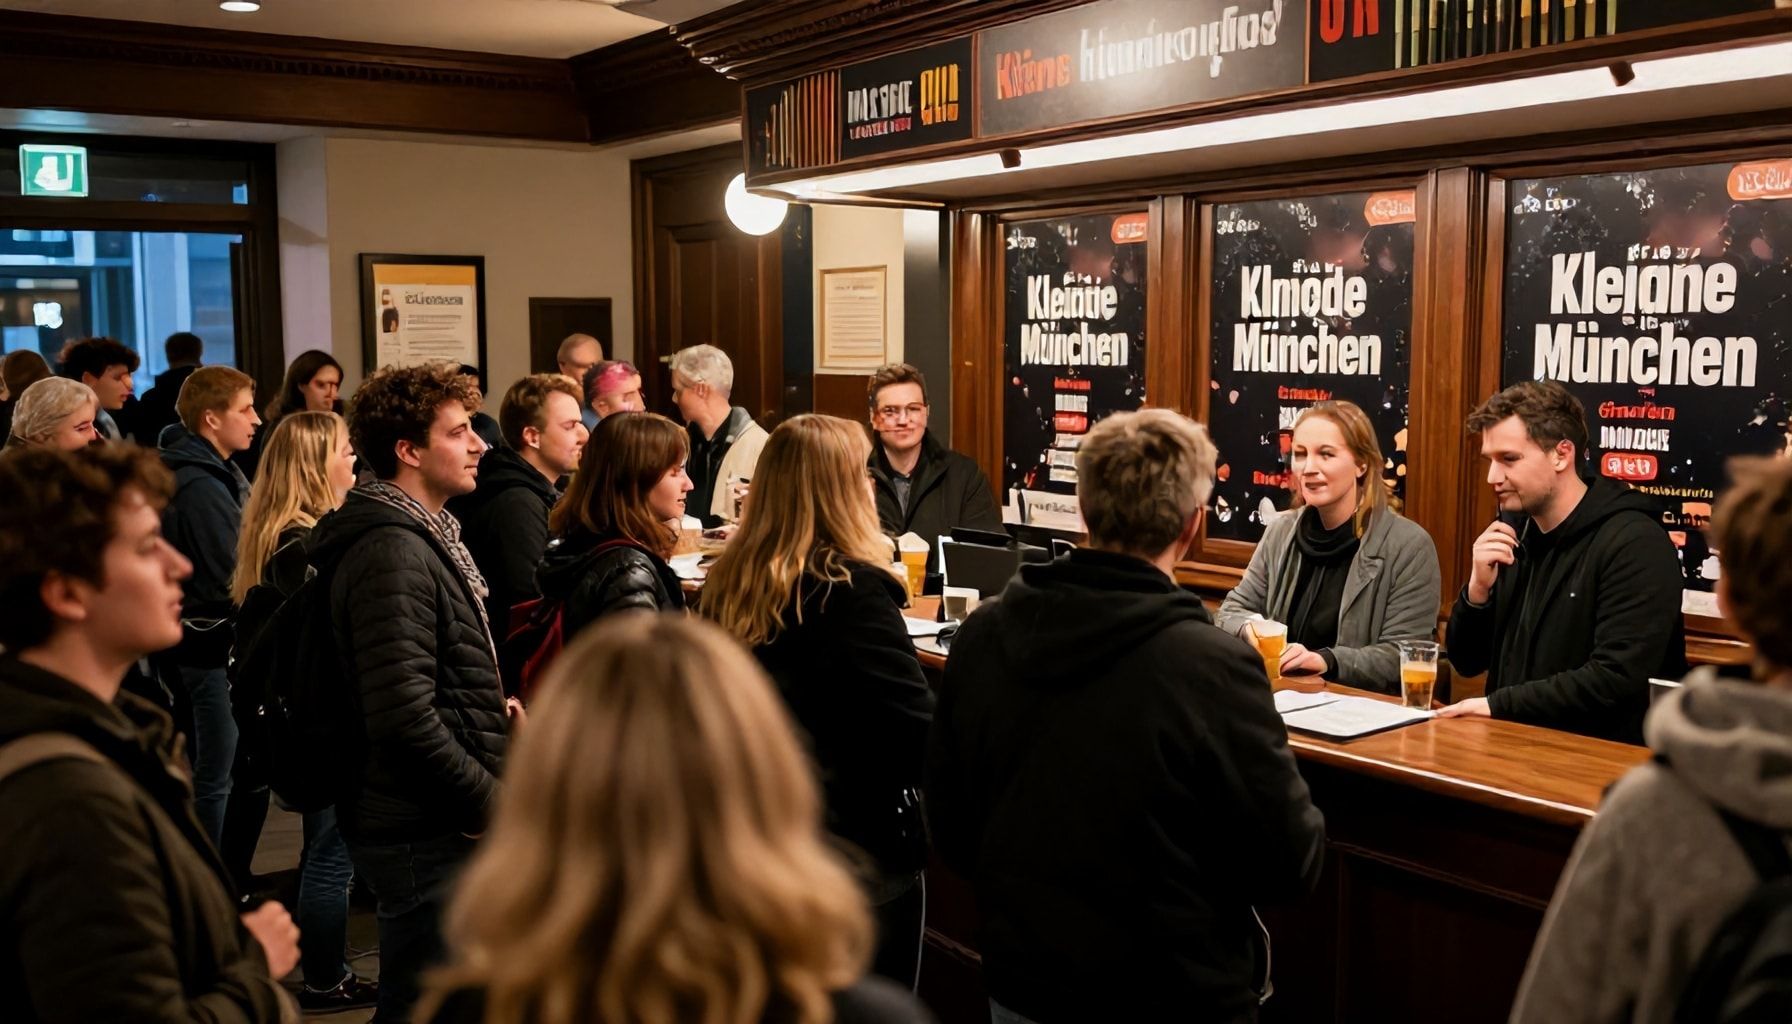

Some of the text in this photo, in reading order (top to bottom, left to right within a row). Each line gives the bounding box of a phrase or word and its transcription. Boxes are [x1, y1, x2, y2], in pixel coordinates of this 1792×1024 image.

[1021, 321, 1128, 366] München
[1233, 321, 1382, 375] München
[1534, 321, 1758, 387] München
